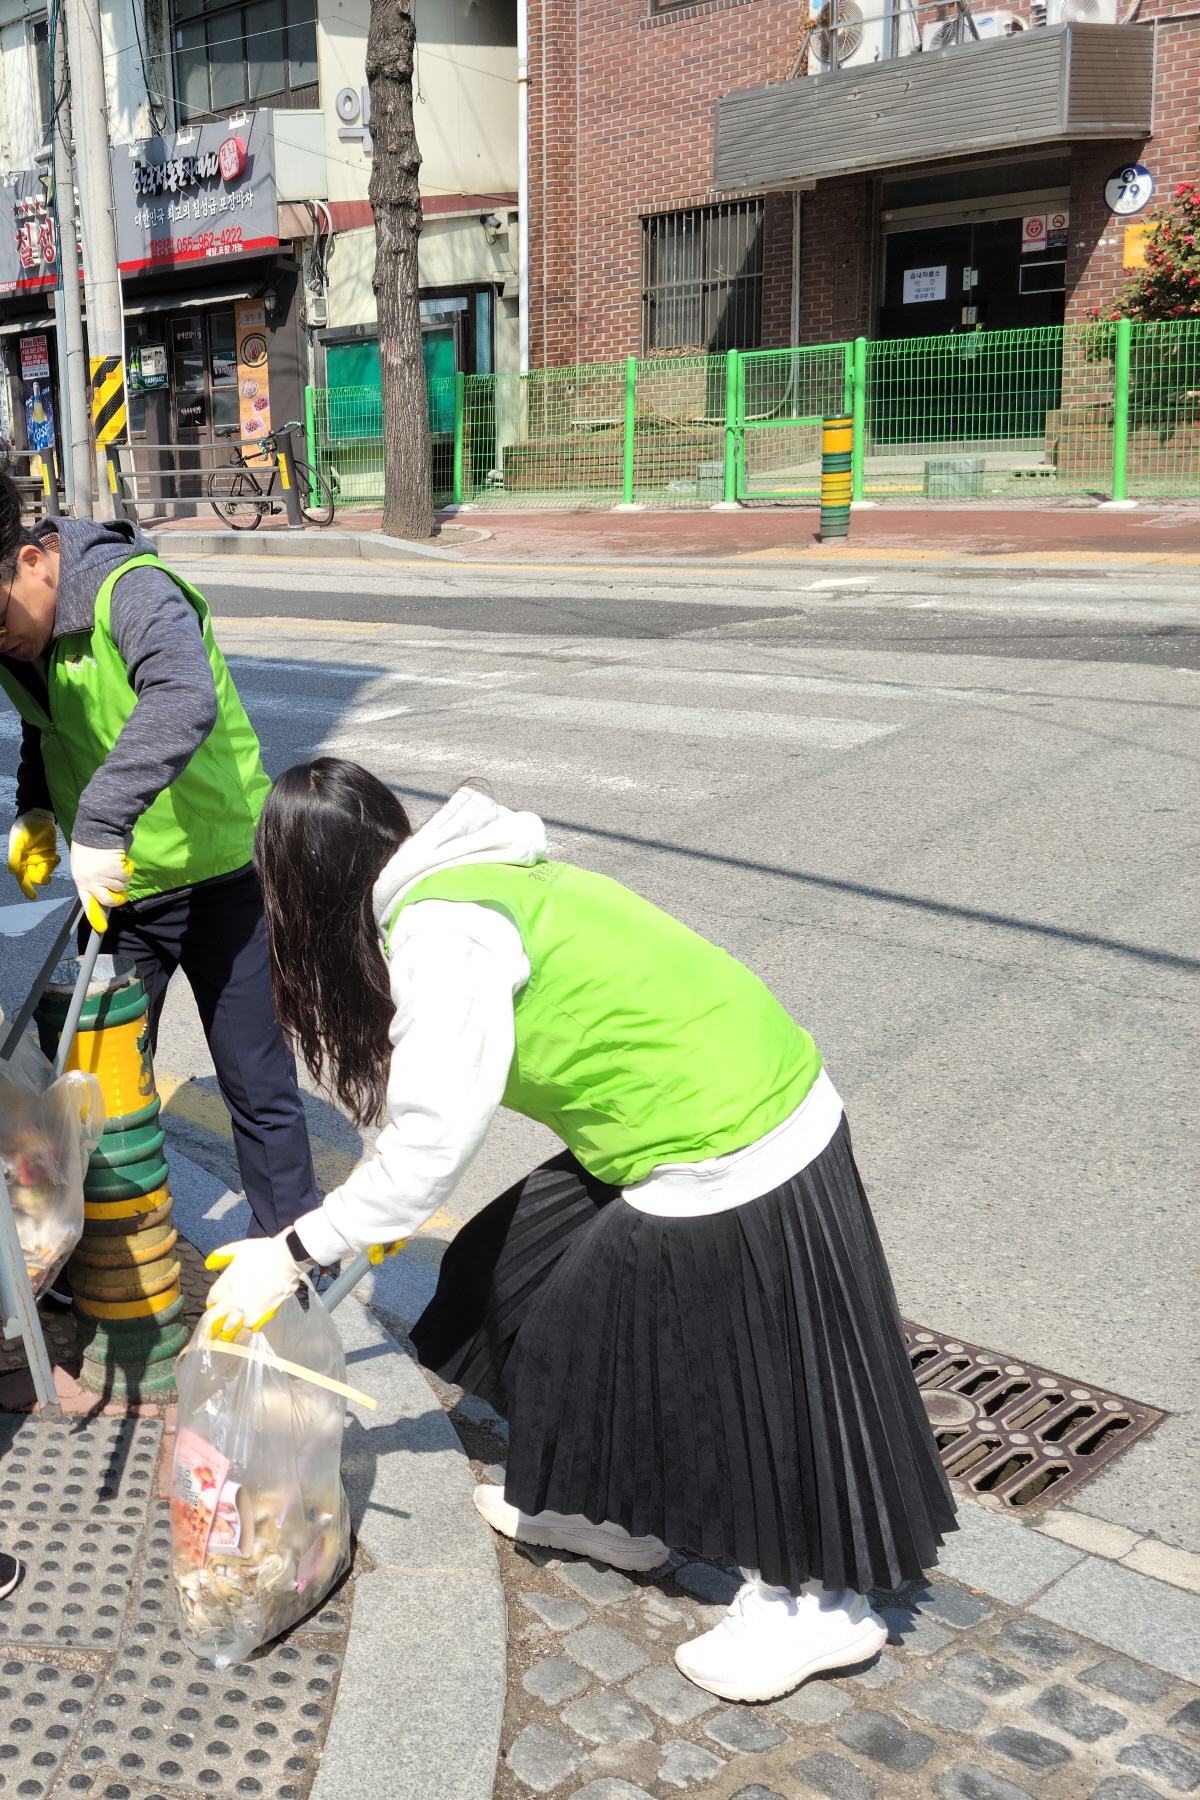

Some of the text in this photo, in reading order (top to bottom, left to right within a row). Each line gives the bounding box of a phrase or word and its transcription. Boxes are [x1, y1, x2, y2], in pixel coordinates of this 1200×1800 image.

[1117, 183, 1141, 200] 79
[134, 188, 254, 230] 대한민국 최고의 칠성급 포장마차
[14, 217, 56, 268] 칠성
[150, 227, 242, 256] 함양점 055-962-4222
[231, 243, 243, 252] 가능
